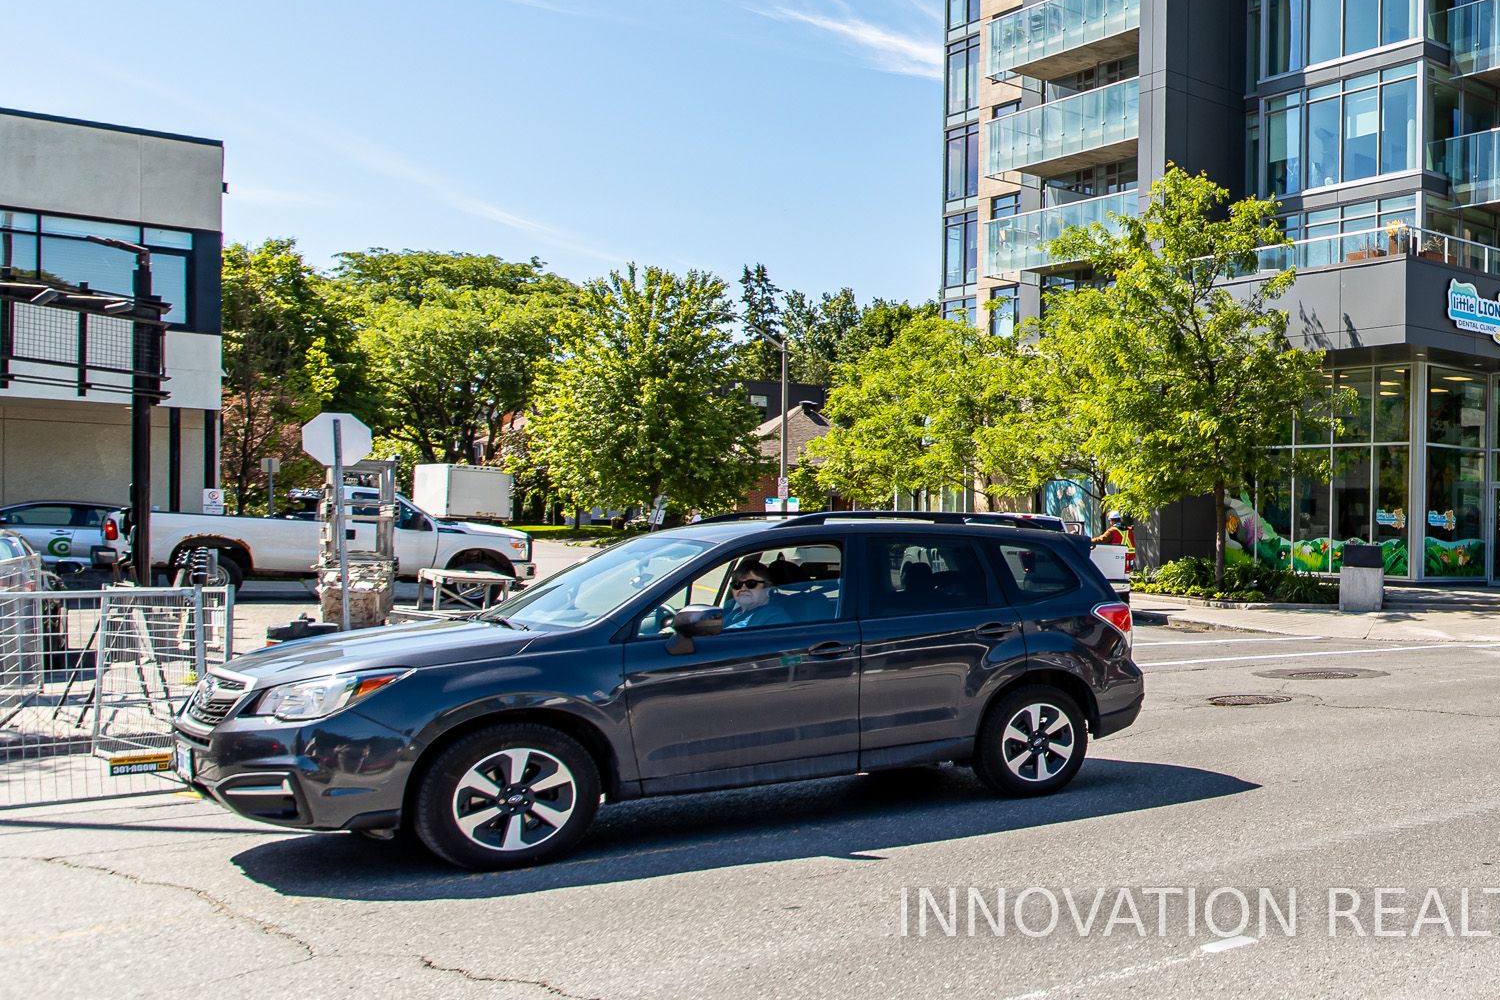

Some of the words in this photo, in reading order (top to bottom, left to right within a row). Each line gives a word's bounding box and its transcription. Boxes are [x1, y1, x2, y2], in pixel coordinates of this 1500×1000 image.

[1453, 295, 1474, 312] little
[1478, 300, 1500, 318] LION
[1458, 319, 1479, 330] DENTAL
[1480, 323, 1497, 333] CLINIC
[113, 763, 157, 774] MODU-LOC
